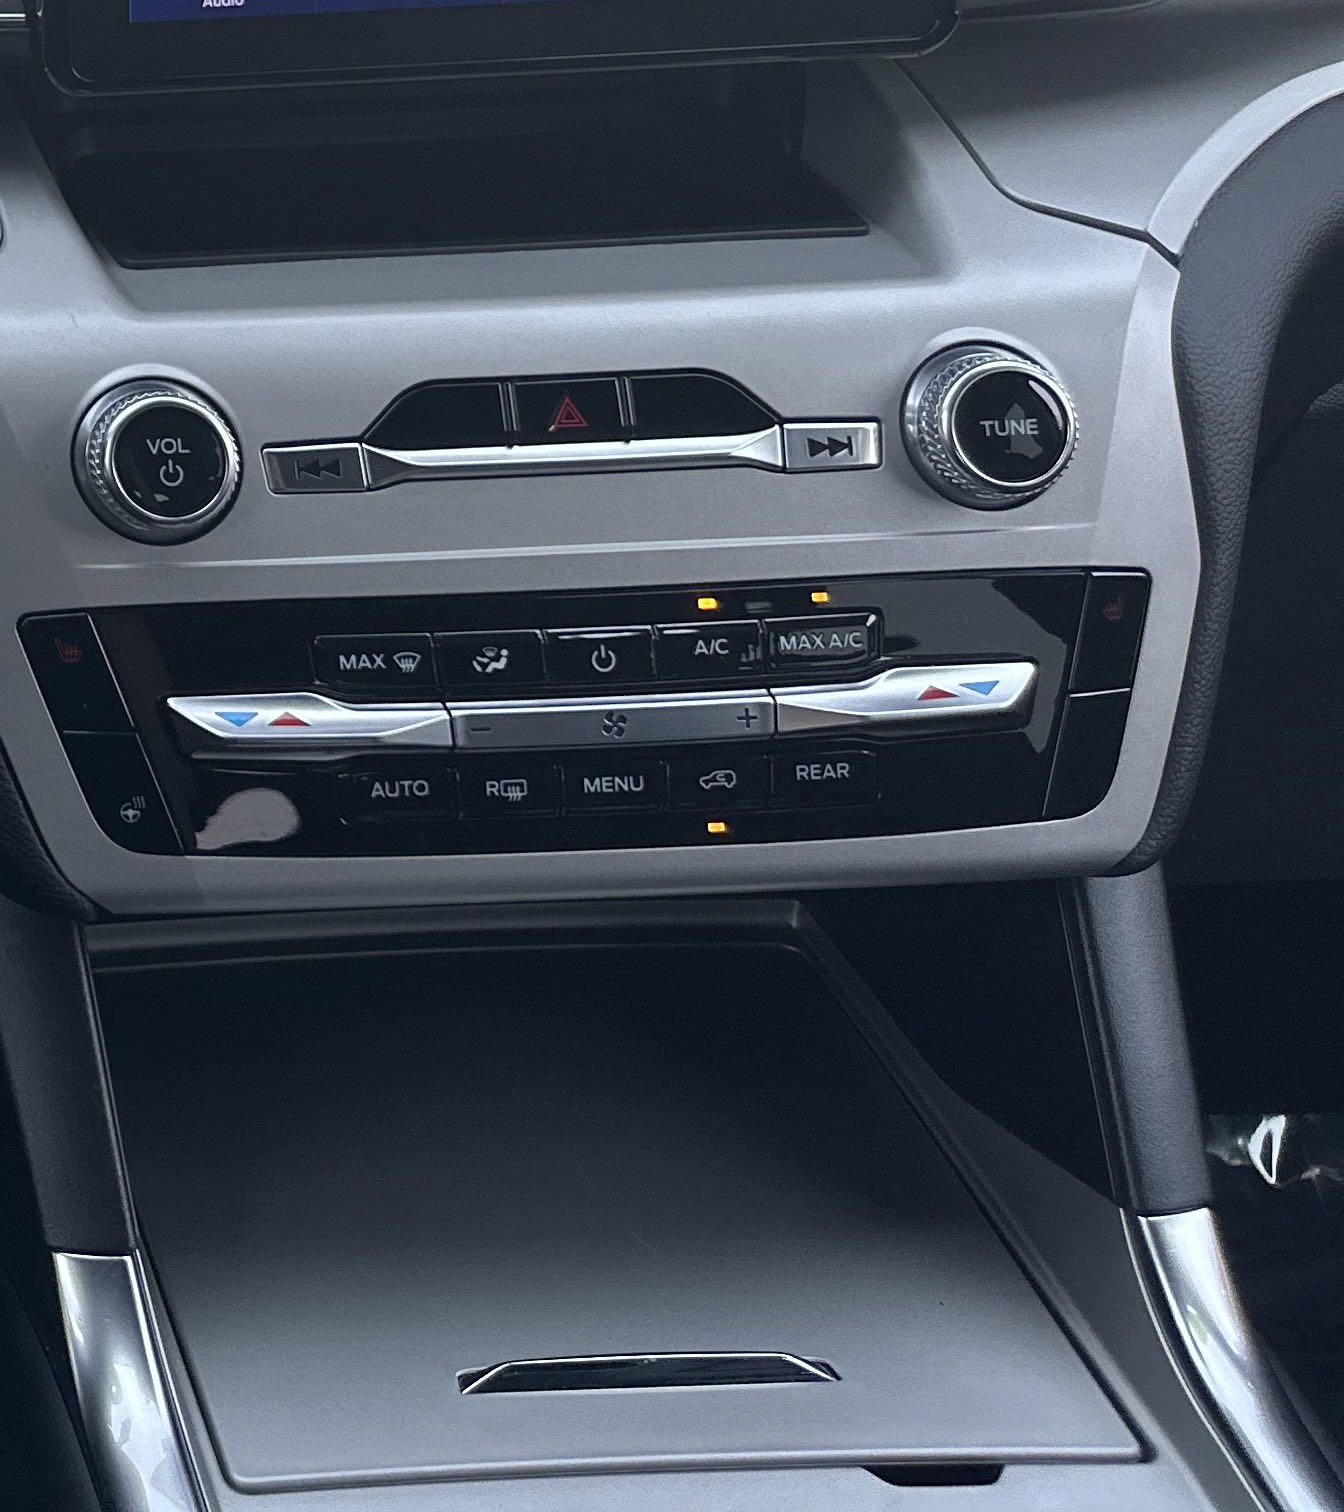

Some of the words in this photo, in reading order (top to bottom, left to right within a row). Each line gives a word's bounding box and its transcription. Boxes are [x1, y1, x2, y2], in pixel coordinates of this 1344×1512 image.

[980, 418, 1040, 437] TUNE
[146, 437, 191, 455] VOL
[694, 637, 730, 658] A/C
[778, 631, 826, 651] MAX
[826, 629, 864, 650] A/C
[338, 652, 386, 672] MAX
[795, 762, 850, 782] REAR
[370, 778, 430, 798] AUTO
[582, 774, 645, 794] MENU
